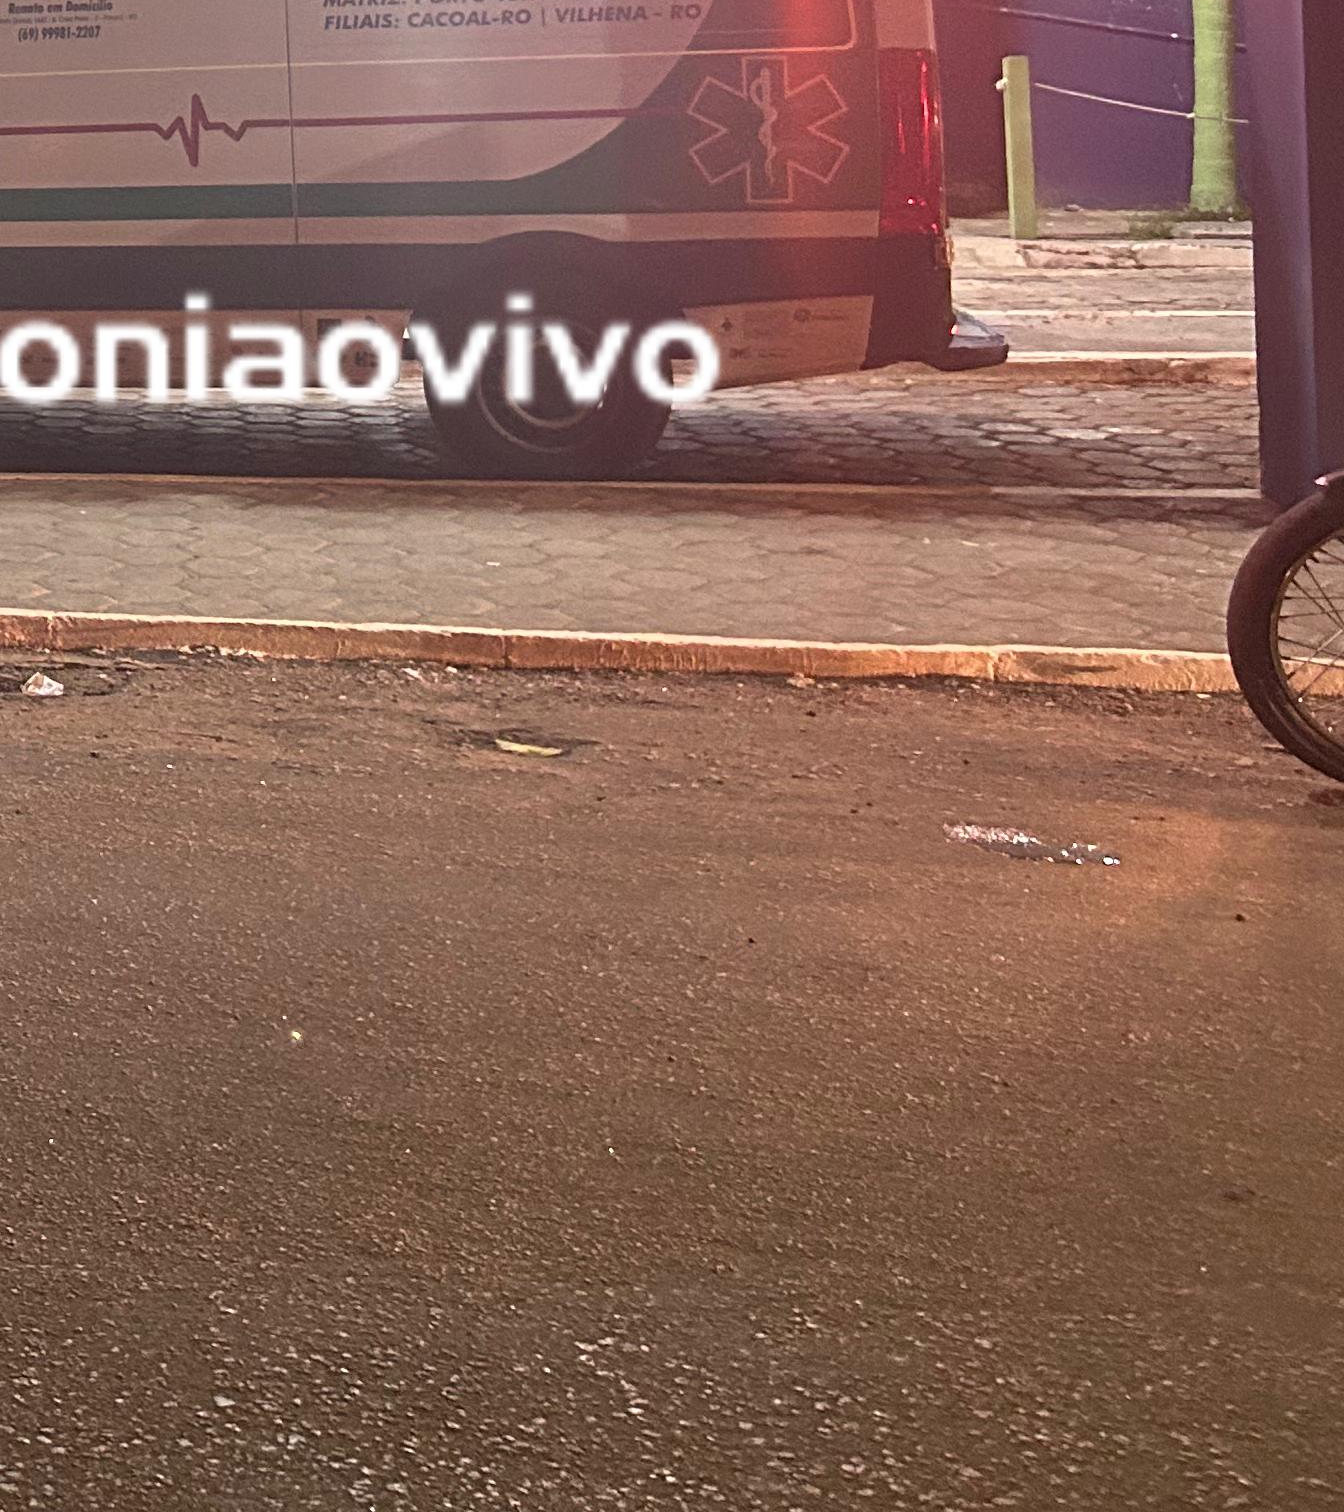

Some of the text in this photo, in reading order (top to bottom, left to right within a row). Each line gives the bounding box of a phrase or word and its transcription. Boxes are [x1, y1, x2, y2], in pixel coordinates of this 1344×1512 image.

[324, 13, 400, 31] FILIAIS:
[406, 8, 533, 28] CACOAL-RO
[554, 5, 649, 24] VILHENA
[669, 3, 702, 20] RO
